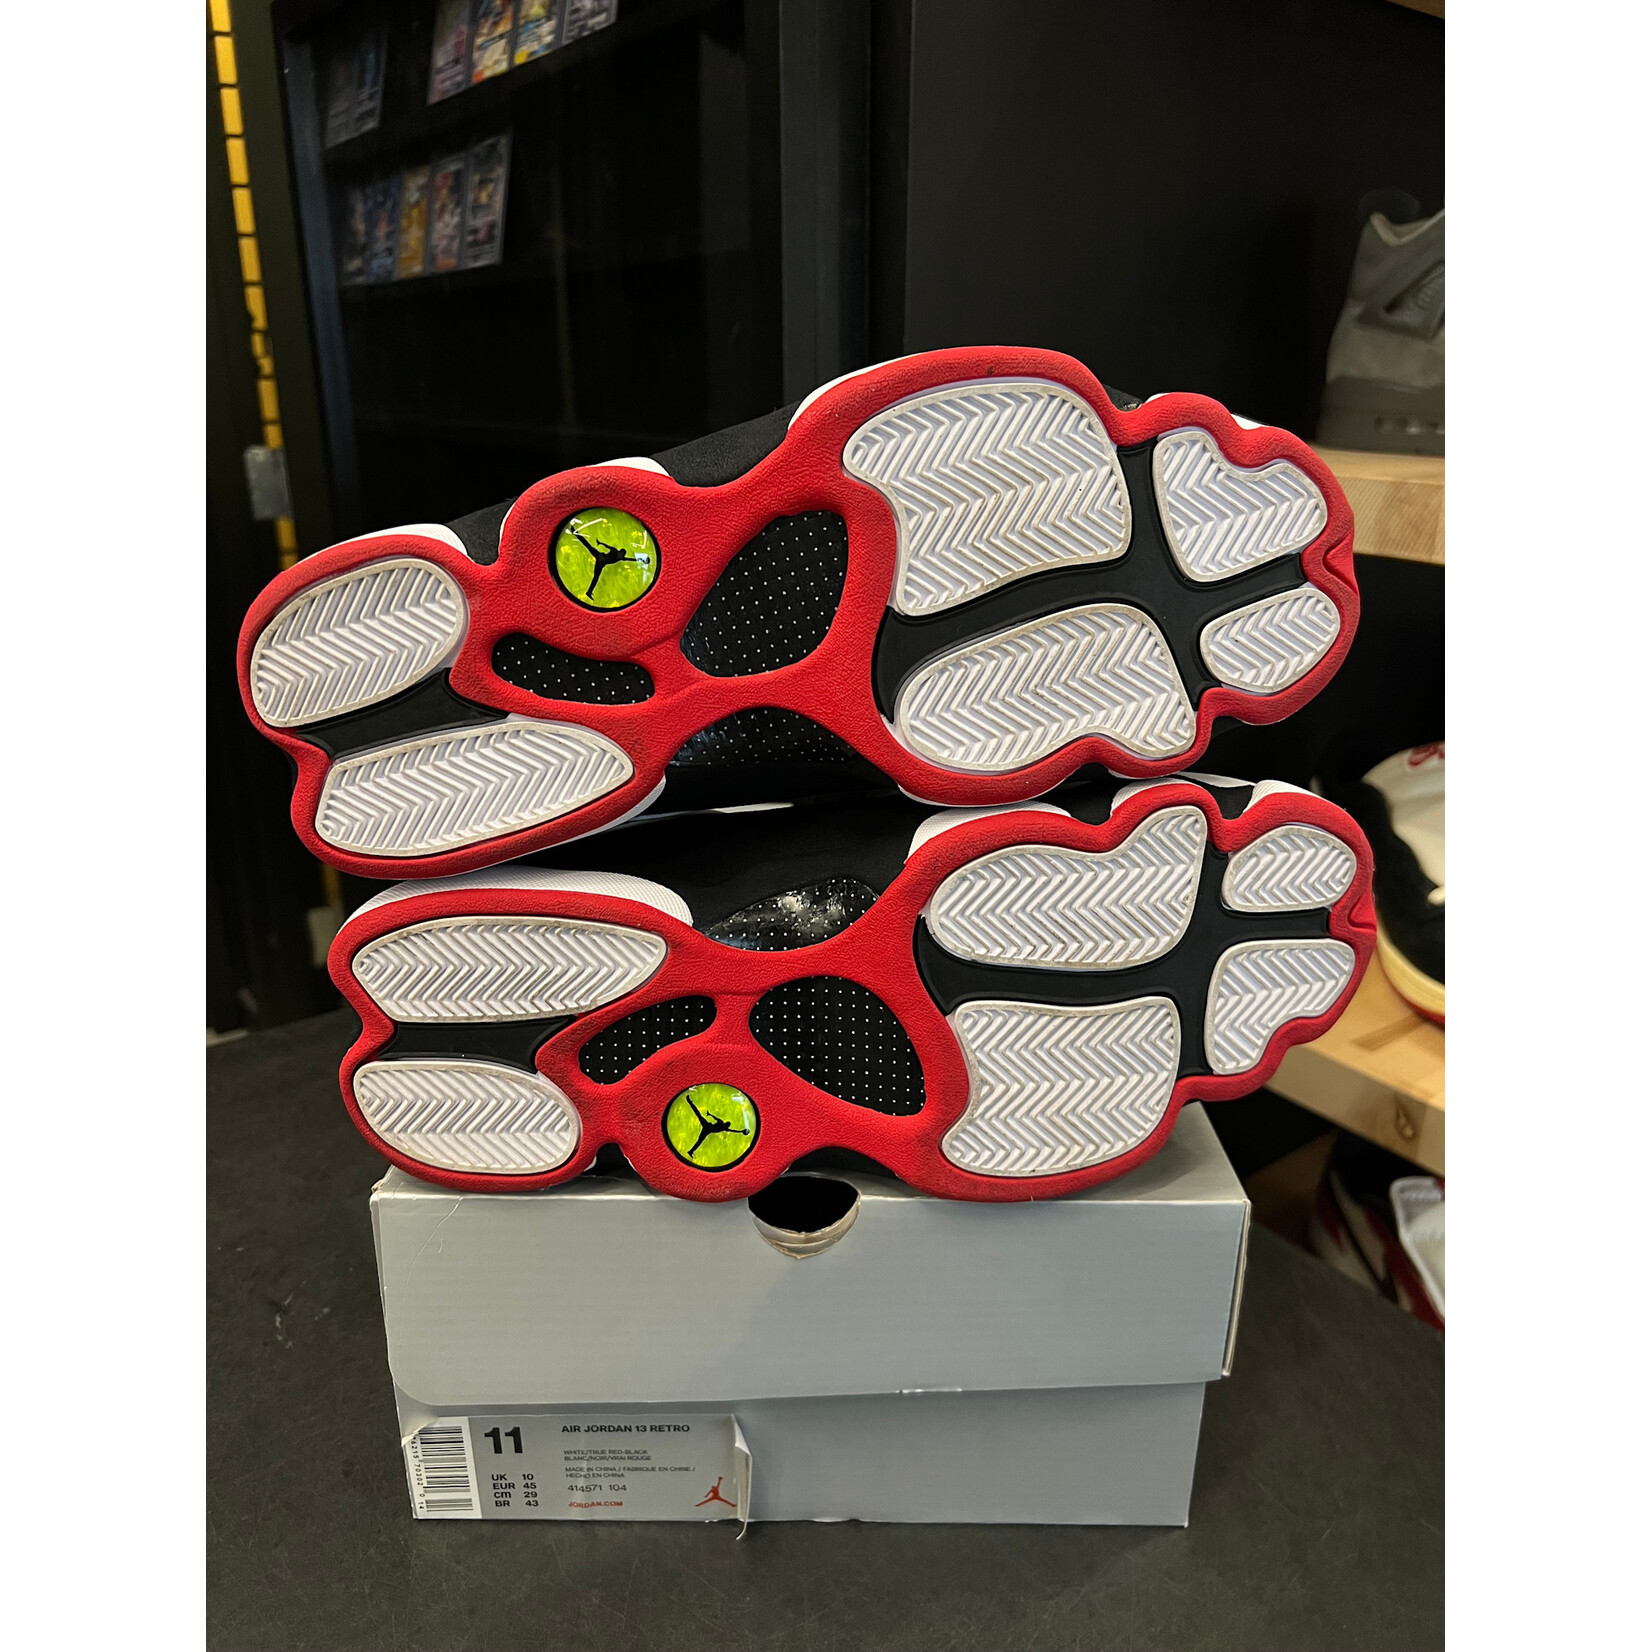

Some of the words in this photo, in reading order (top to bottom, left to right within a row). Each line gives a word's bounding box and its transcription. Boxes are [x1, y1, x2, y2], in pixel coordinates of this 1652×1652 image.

[561, 1425, 581, 1433] AIR
[584, 1425, 632, 1433] JORDAN
[636, 1425, 647, 1433] 13
[650, 1424, 690, 1432] RETRO
[484, 1426, 523, 1454] 11
[491, 1473, 507, 1481] UK
[522, 1473, 534, 1481] 10
[493, 1482, 516, 1490] EUR
[567, 1484, 602, 1492] 414571
[494, 1491, 511, 1499] cm
